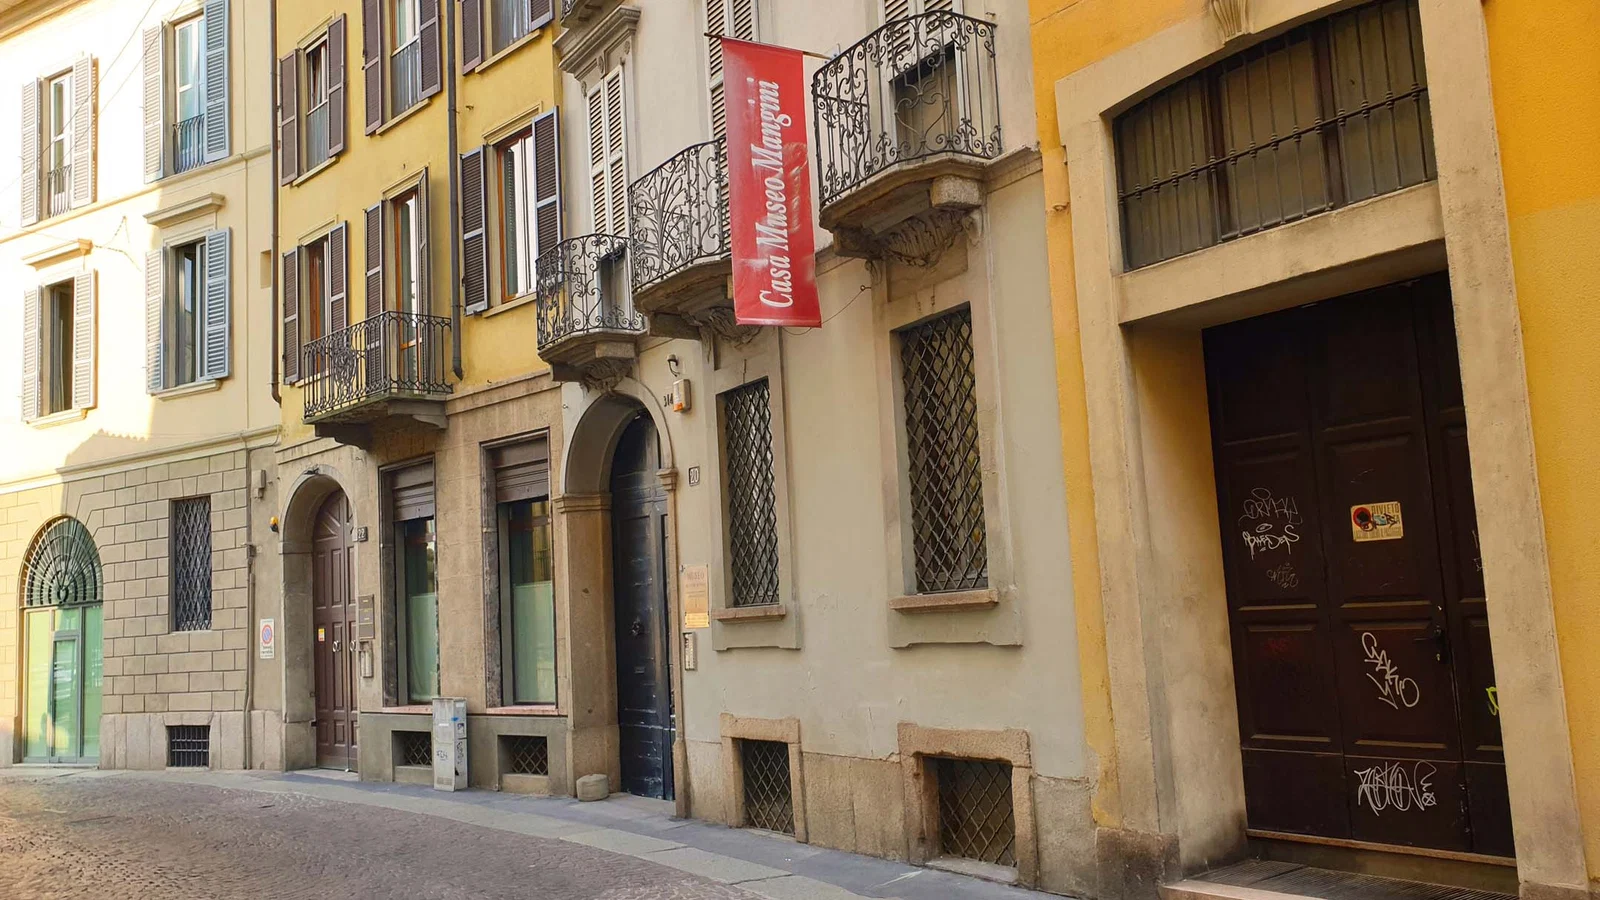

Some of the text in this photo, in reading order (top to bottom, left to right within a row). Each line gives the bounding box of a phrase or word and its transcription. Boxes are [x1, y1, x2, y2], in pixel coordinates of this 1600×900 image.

[746, 77, 793, 308] Casa Museo Mangini
[690, 468, 699, 484] 20
[1371, 503, 1400, 515] DIVIETO
